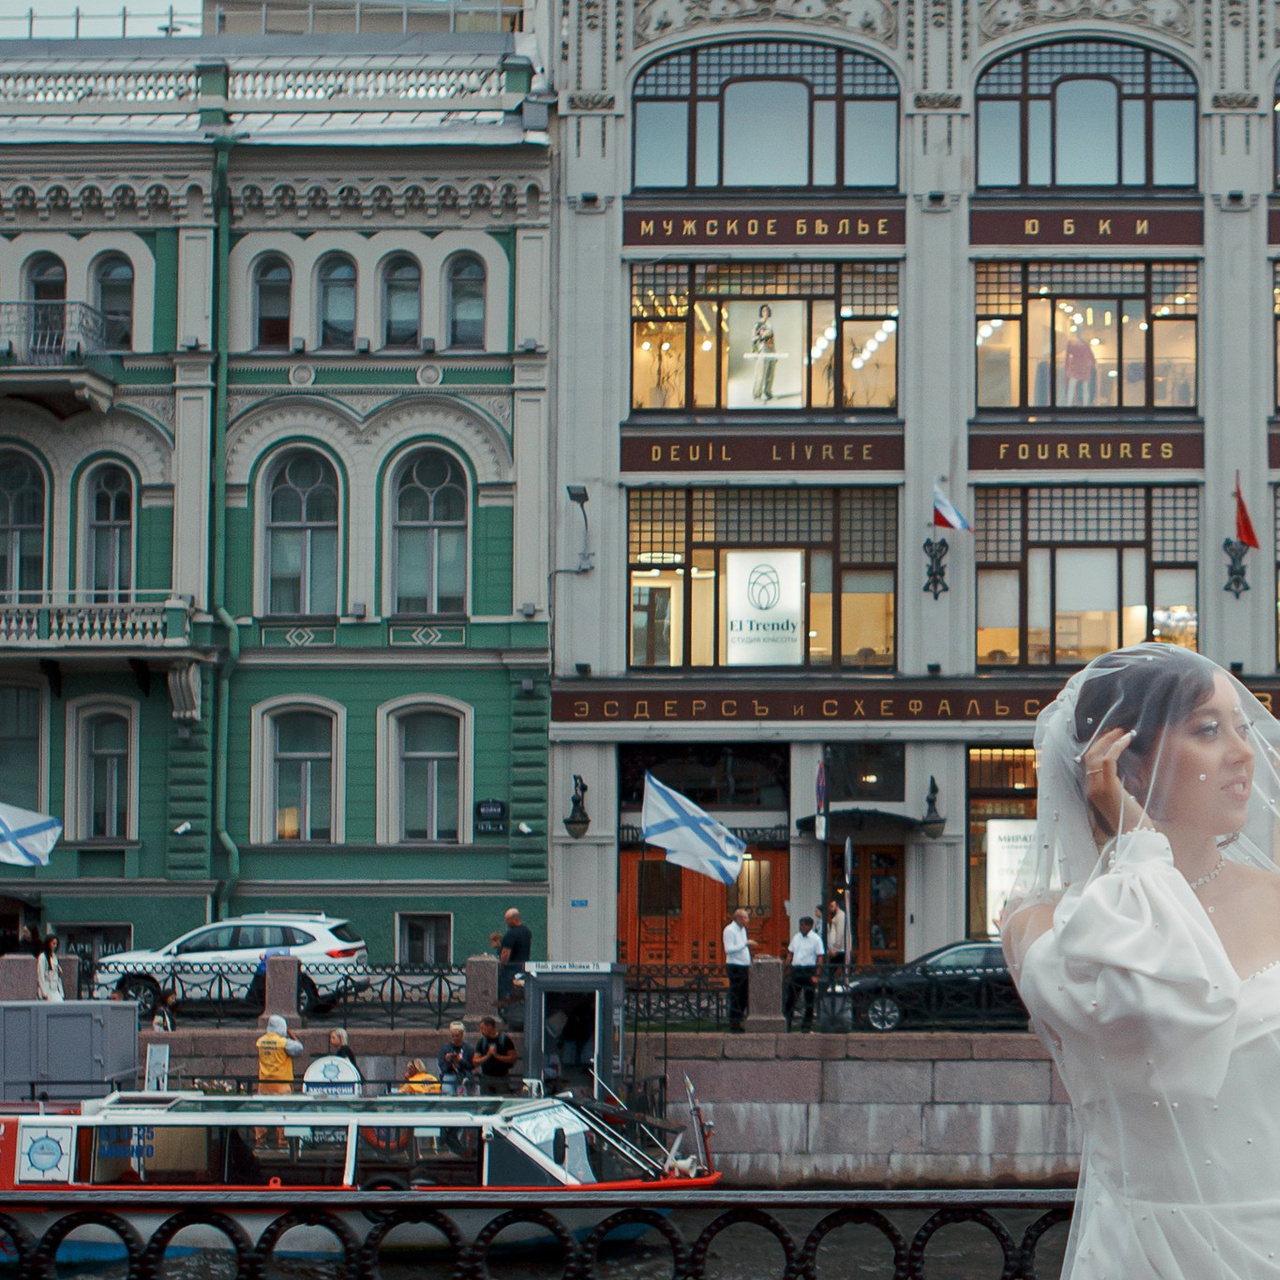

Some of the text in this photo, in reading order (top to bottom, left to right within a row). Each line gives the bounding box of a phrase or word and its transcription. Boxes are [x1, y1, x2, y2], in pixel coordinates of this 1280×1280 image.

[640, 219, 778, 237] МУЖСКОЕ
[1024, 219, 1149, 236] ЮБКИ
[651, 442, 874, 463] DEUIL LIVREE
[999, 442, 1175, 461] FOURRURES
[747, 619, 798, 634] Trendy
[574, 700, 770, 719] ЭСДЕРСЪ
